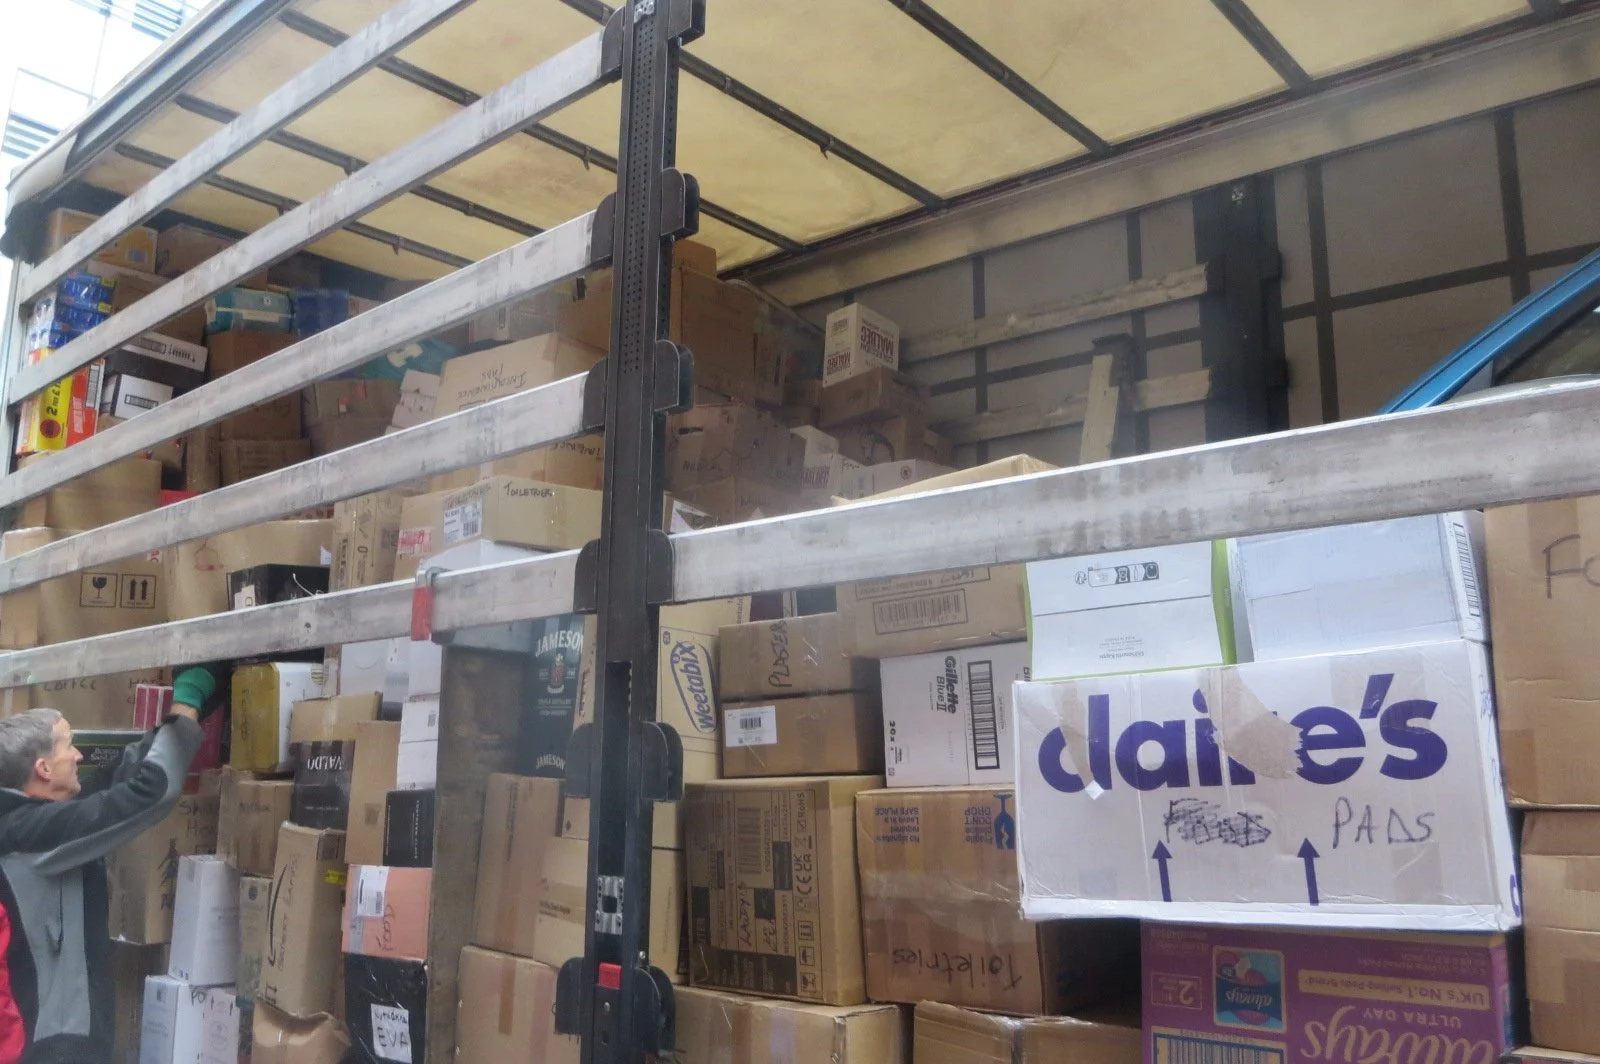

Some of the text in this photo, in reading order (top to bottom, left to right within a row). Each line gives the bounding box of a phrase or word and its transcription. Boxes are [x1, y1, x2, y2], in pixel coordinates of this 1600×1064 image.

[535, 629, 584, 657] JAMESON
[671, 640, 715, 731] Weetabix
[936, 675, 945, 702] Blue
[944, 655, 959, 714] Gillette
[535, 752, 566, 771] JAMESON
[874, 806, 919, 816] SAFE PLACE
[964, 806, 993, 816] DROP
[964, 816, 993, 826] DON'T
[1332, 796, 1437, 850] PADS
[893, 949, 1022, 992] Toiletries
[1224, 989, 1274, 1012] always
[1407, 984, 1442, 1001] No.1
[1447, 986, 1485, 1005] UK's
[1363, 1007, 1463, 1029] ULTRA DAY
